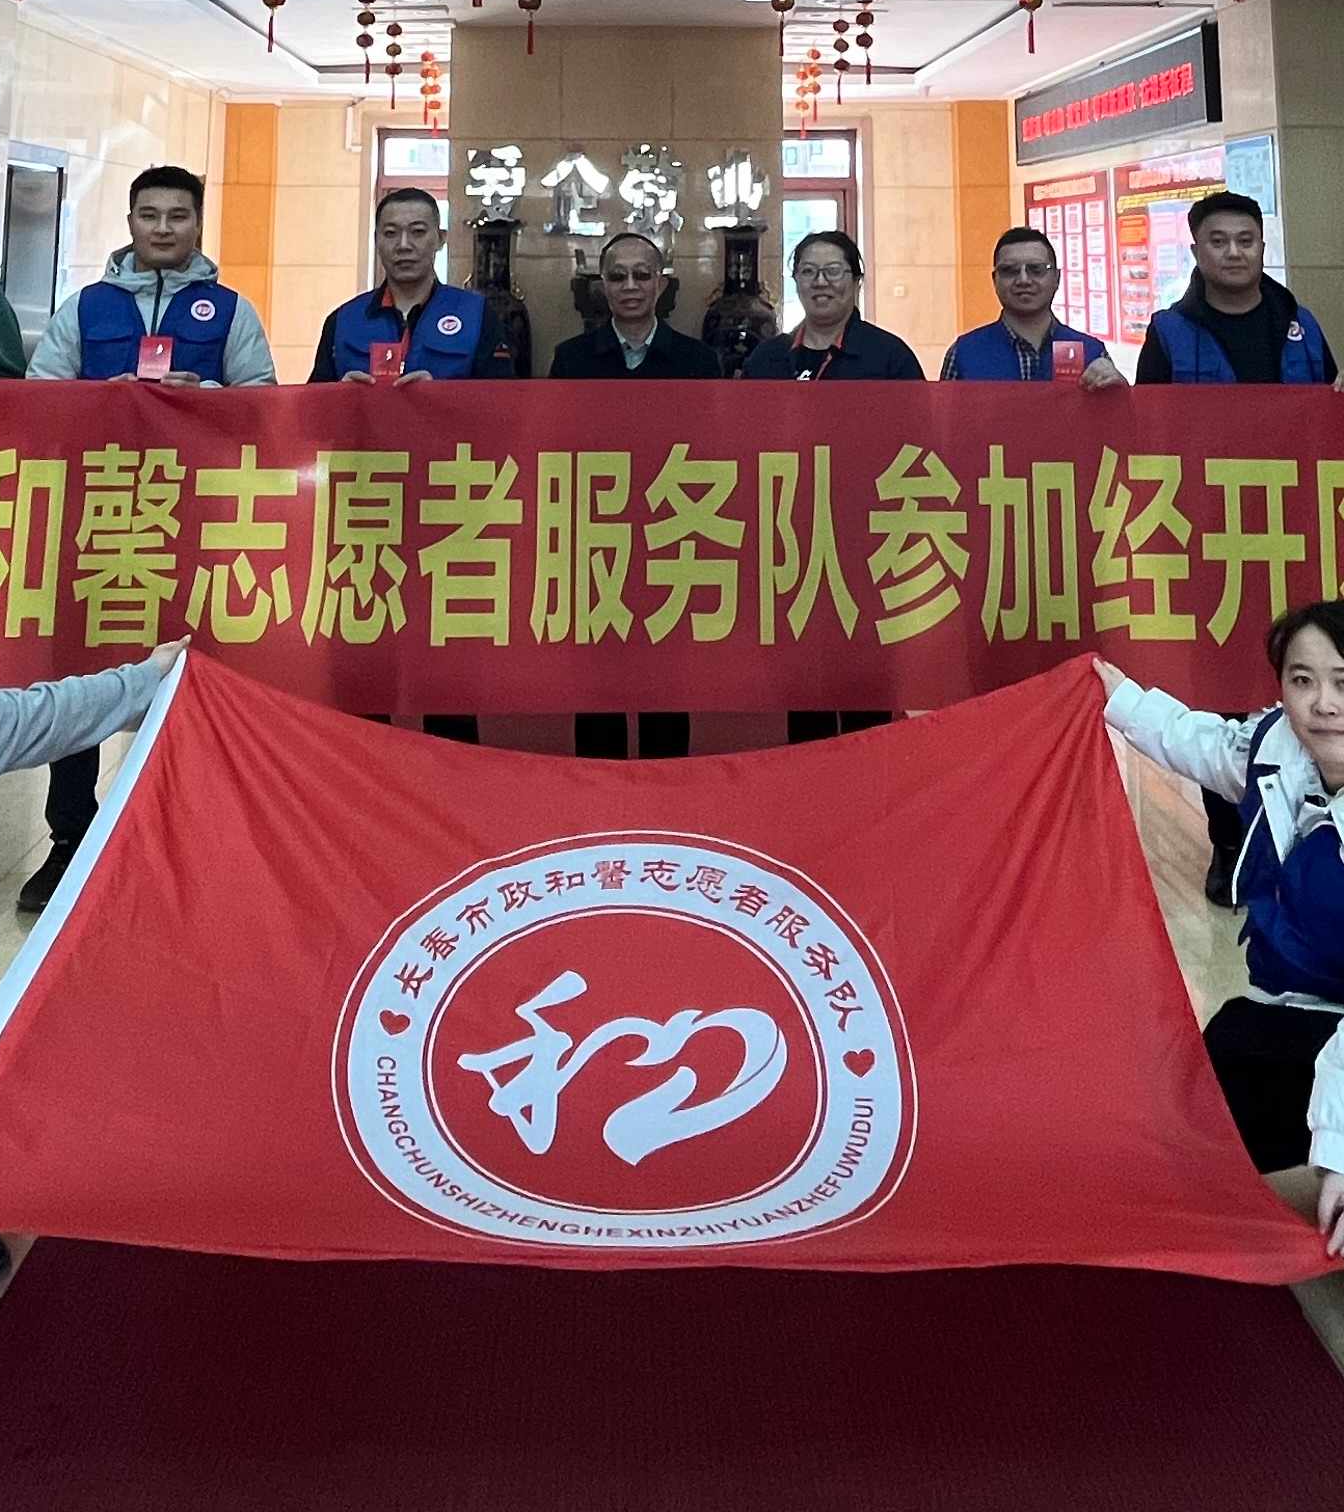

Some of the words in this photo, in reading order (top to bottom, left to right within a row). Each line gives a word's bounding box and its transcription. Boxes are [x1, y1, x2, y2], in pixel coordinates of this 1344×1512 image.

[393, 859, 865, 1032] 长春市政和馨志愿者服务队
